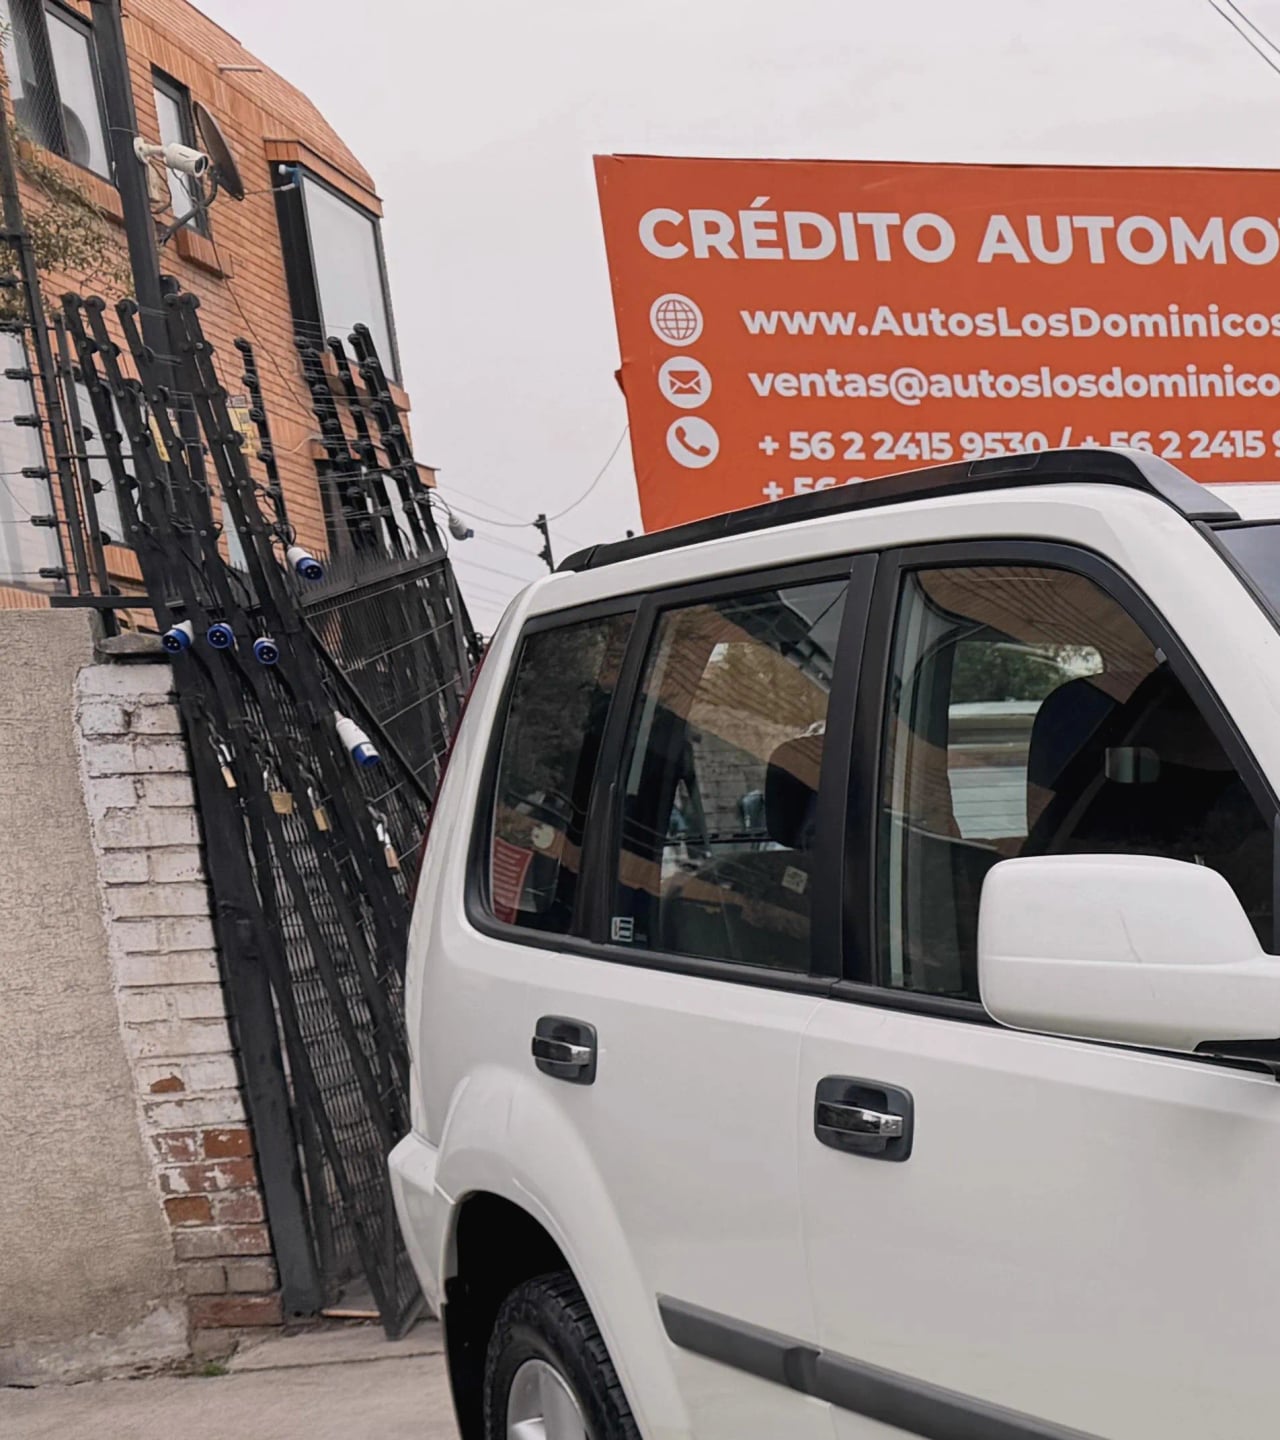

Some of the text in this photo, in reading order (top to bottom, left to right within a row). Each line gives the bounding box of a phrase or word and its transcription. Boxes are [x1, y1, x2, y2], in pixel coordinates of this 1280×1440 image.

[638, 196, 955, 263] CRÉDITO
[789, 430, 836, 461] 56
[840, 431, 866, 461] 2
[871, 431, 954, 461] 2415
[1156, 430, 1183, 459] 2
[1187, 429, 1266, 459] 2415
